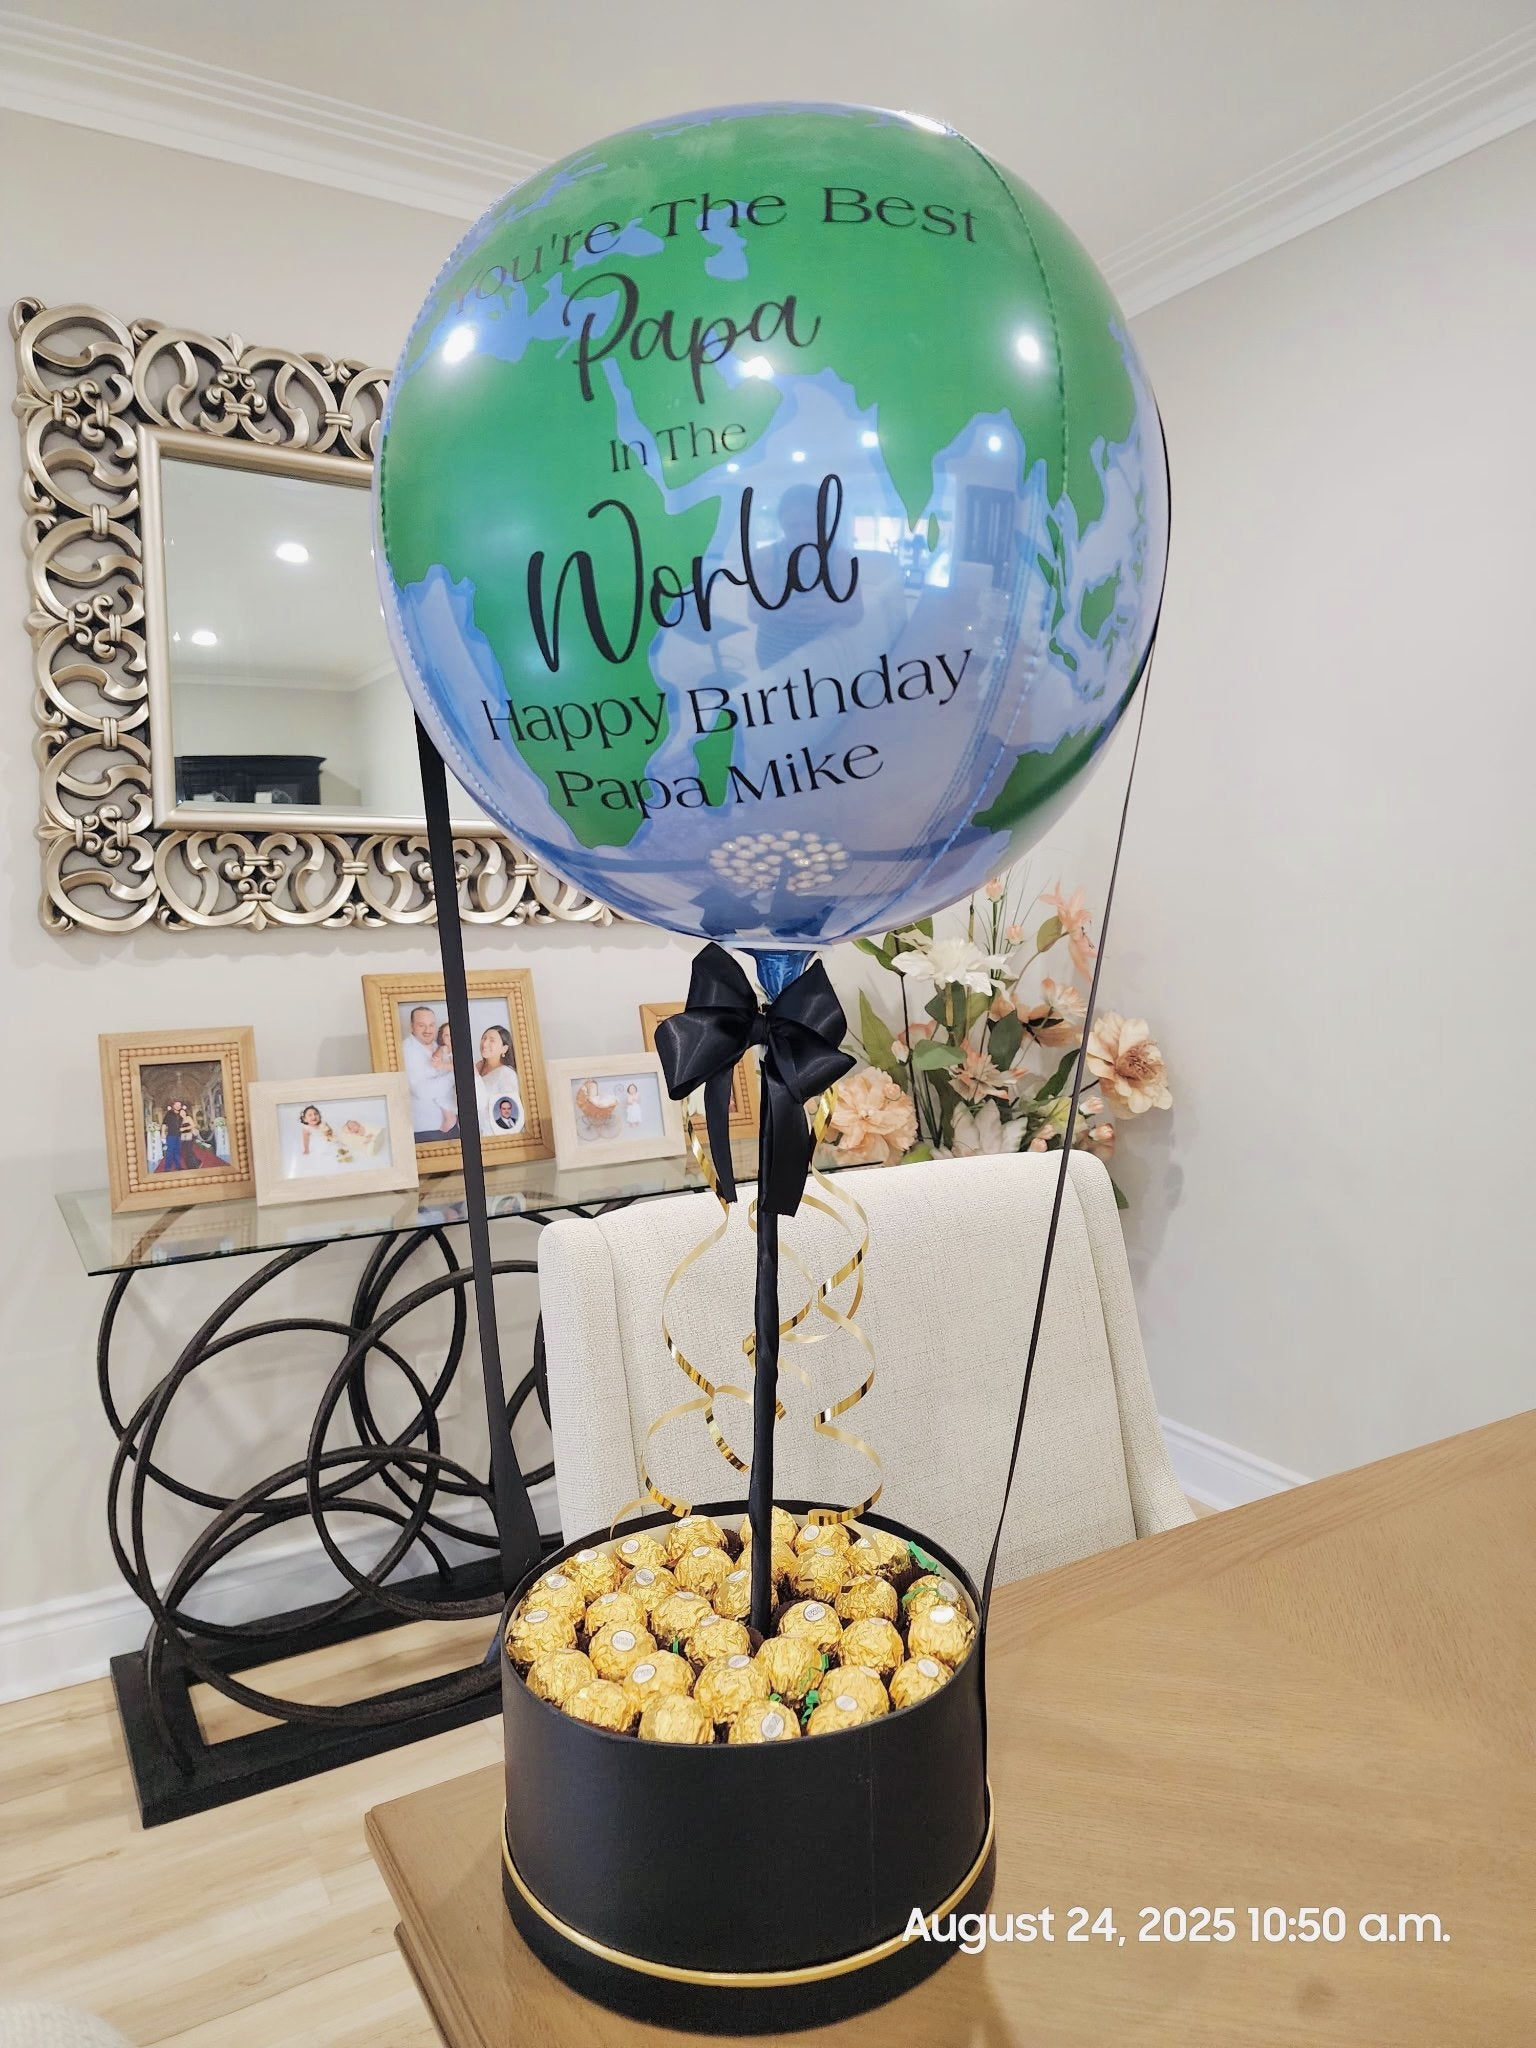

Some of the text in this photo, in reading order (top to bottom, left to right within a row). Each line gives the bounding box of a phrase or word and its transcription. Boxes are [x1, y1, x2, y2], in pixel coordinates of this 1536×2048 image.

[650, 192, 787, 239] The
[821, 186, 979, 243] Best
[562, 271, 822, 404] Papa
[609, 420, 749, 473] In The
[527, 474, 859, 673] World
[481, 648, 973, 752] Happy Birthday
[554, 742, 884, 819] Papa Mike
